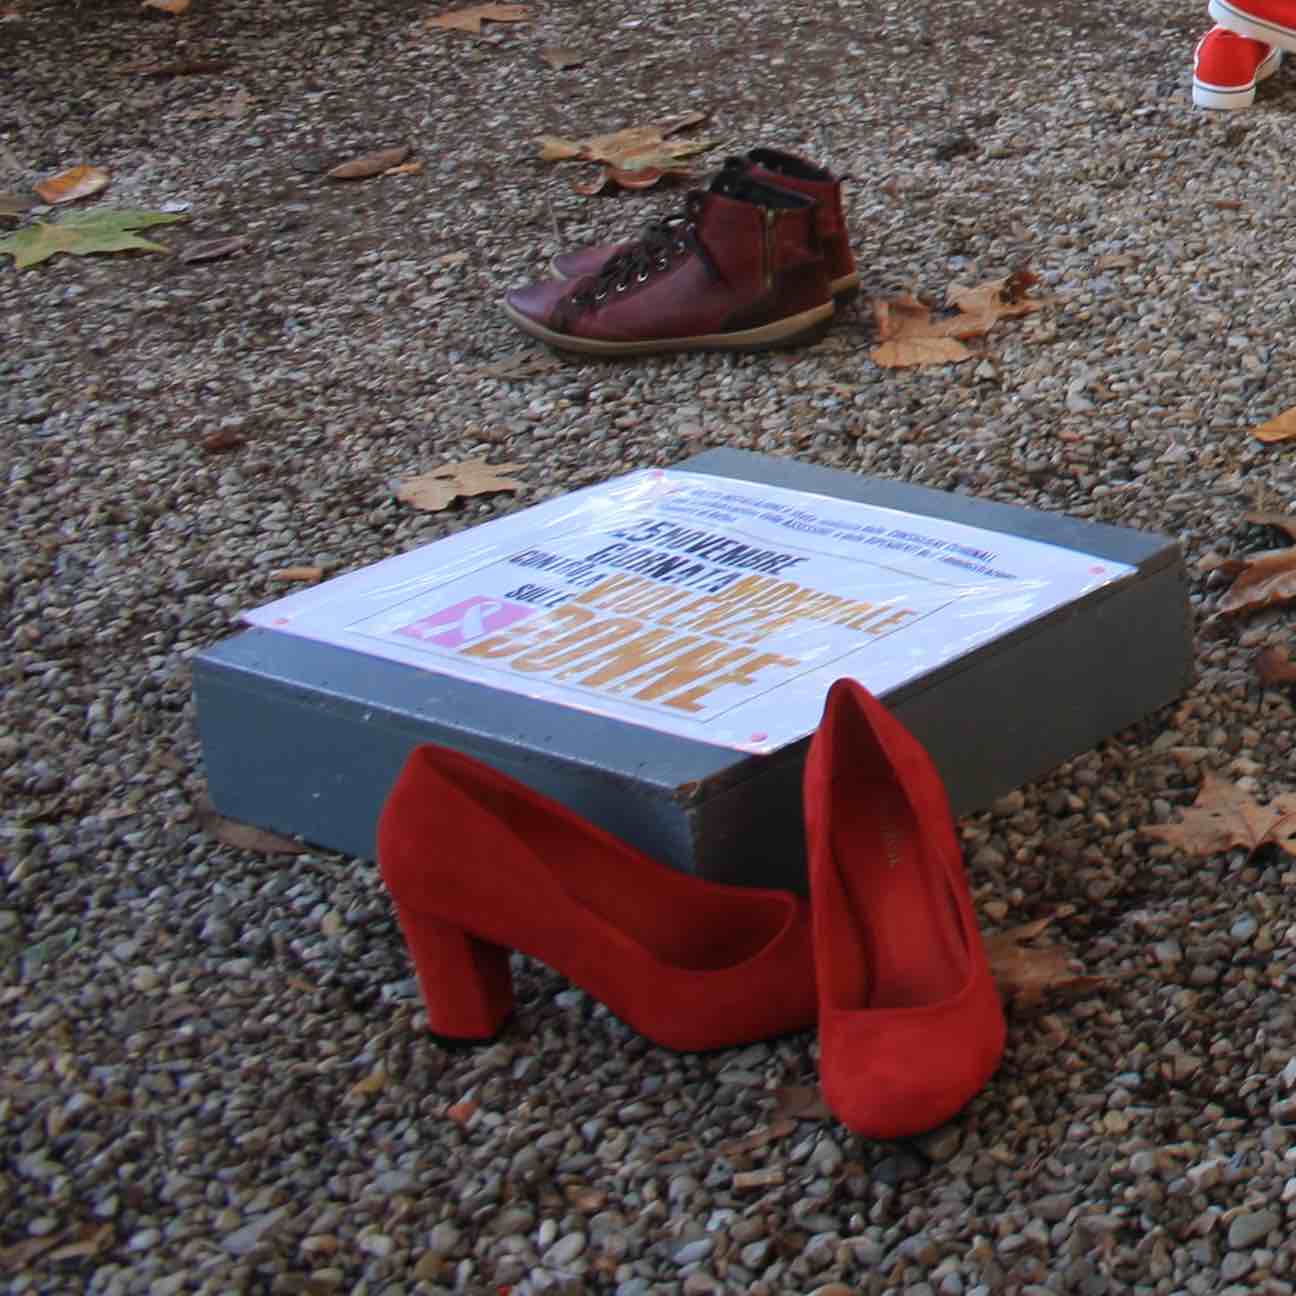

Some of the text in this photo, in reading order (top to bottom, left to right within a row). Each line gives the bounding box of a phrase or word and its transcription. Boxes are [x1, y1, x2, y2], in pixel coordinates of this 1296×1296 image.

[510, 550, 595, 578] CONTRO
[572, 572, 799, 644] VIOLENZA
[586, 543, 918, 636] GIORNATA MONDIALE
[459, 583, 802, 712] SULLE DONNE
